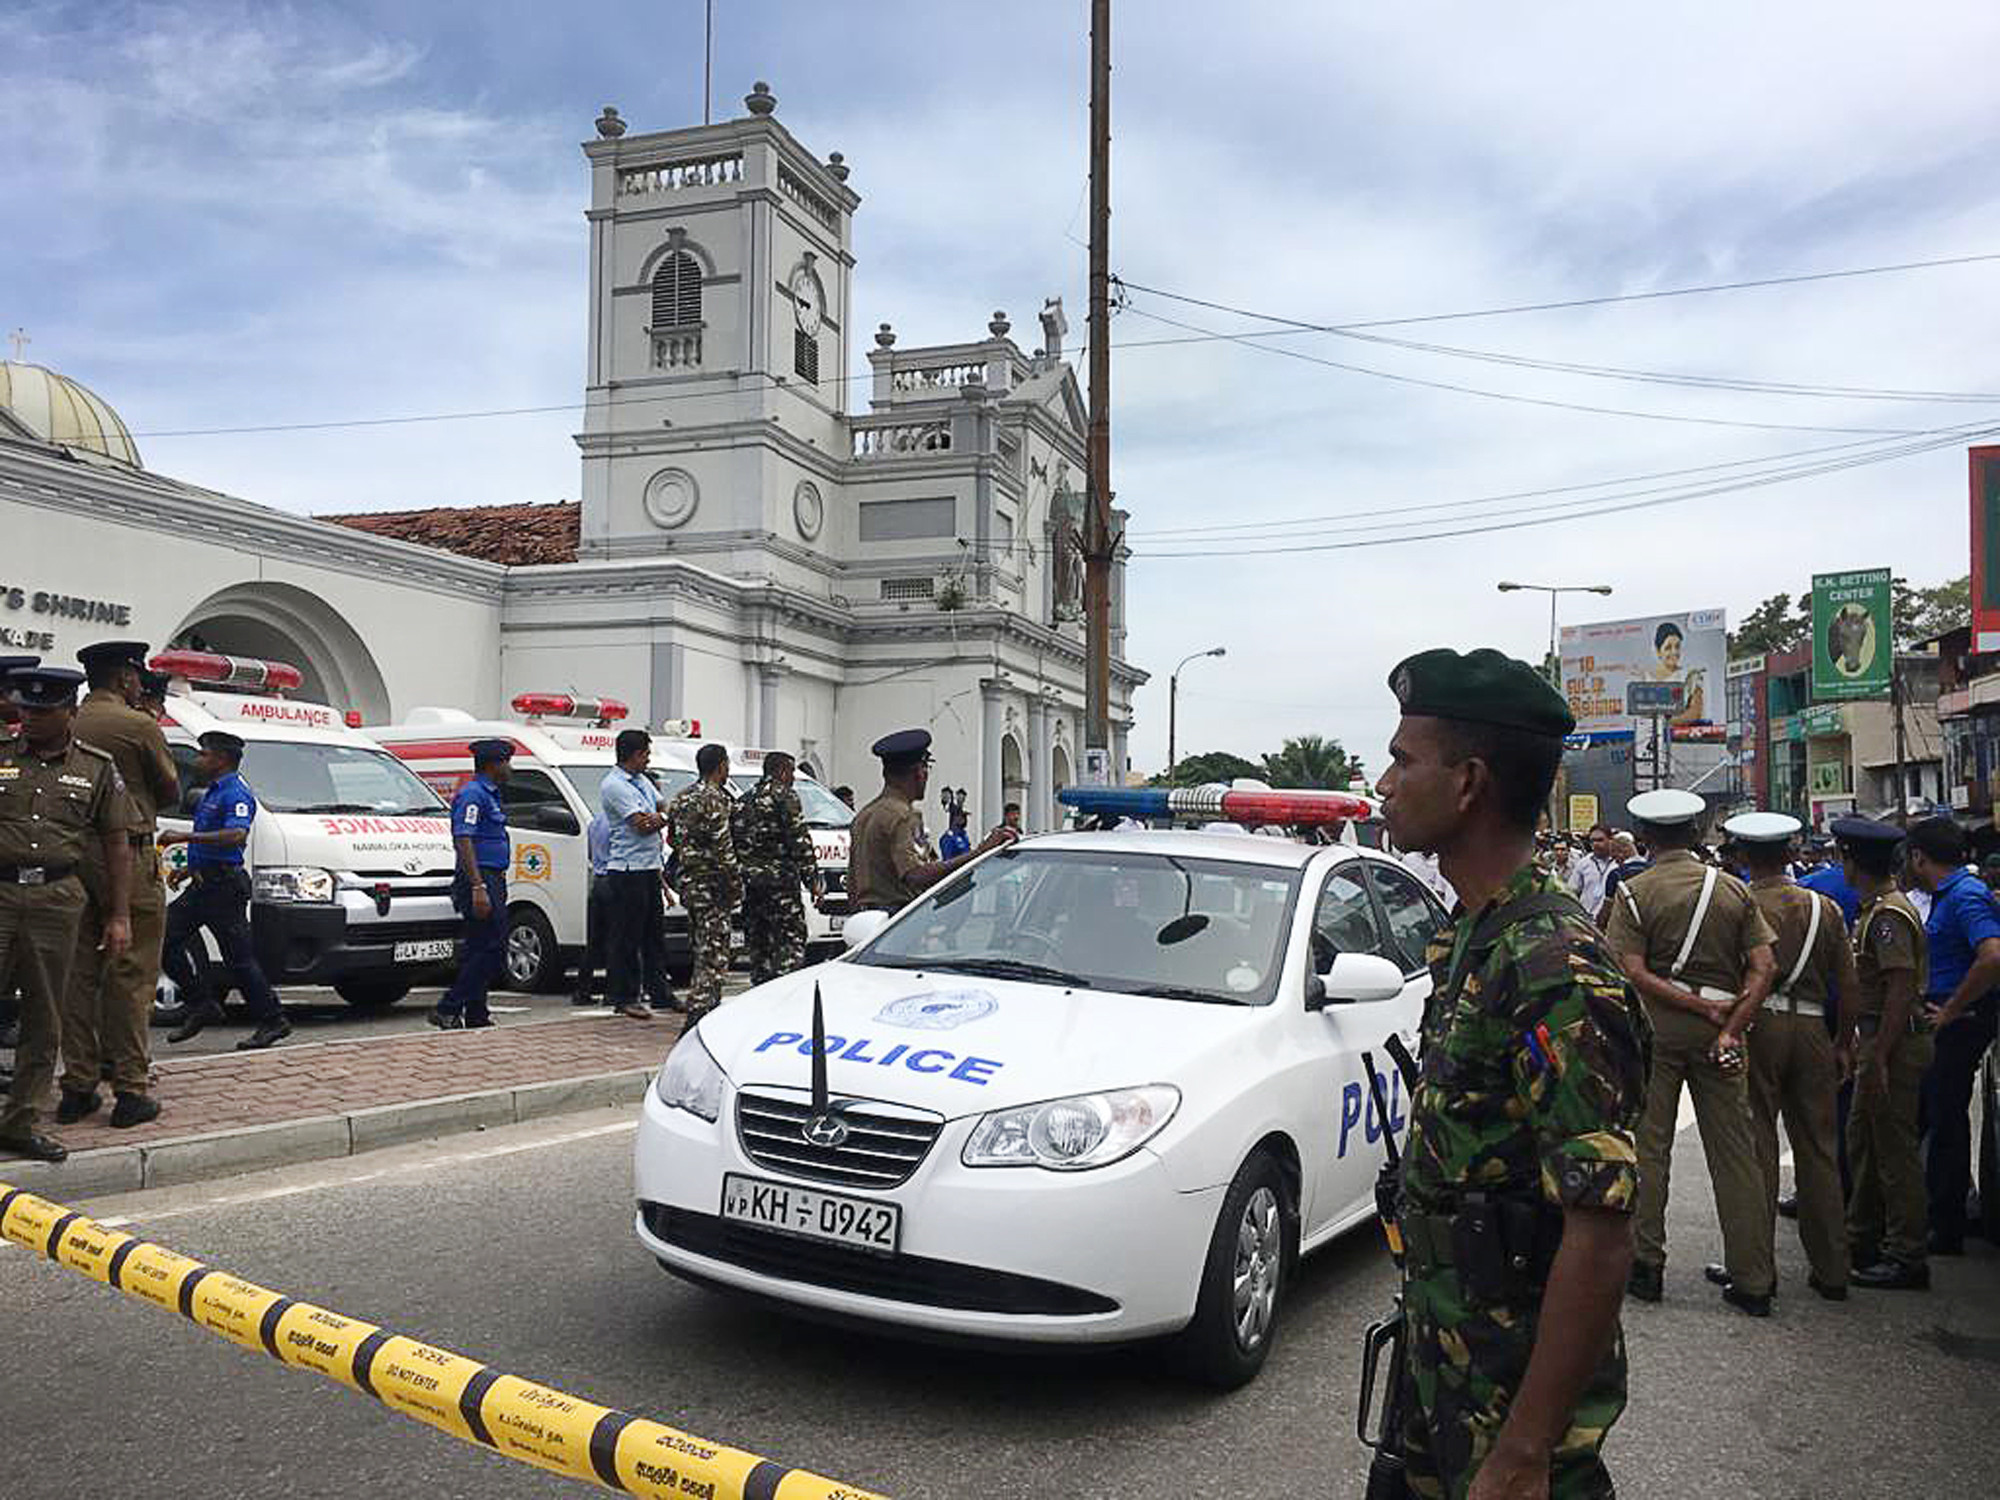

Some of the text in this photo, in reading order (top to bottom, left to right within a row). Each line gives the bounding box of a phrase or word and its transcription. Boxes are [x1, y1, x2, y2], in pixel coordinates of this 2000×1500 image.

[31, 591, 132, 626] SHRINE
[241, 703, 330, 725] AMBULANCE
[352, 842, 411, 852] NAWALOKA
[753, 1032, 1004, 1086] POLICE
[1337, 1068, 1406, 1160] POL
